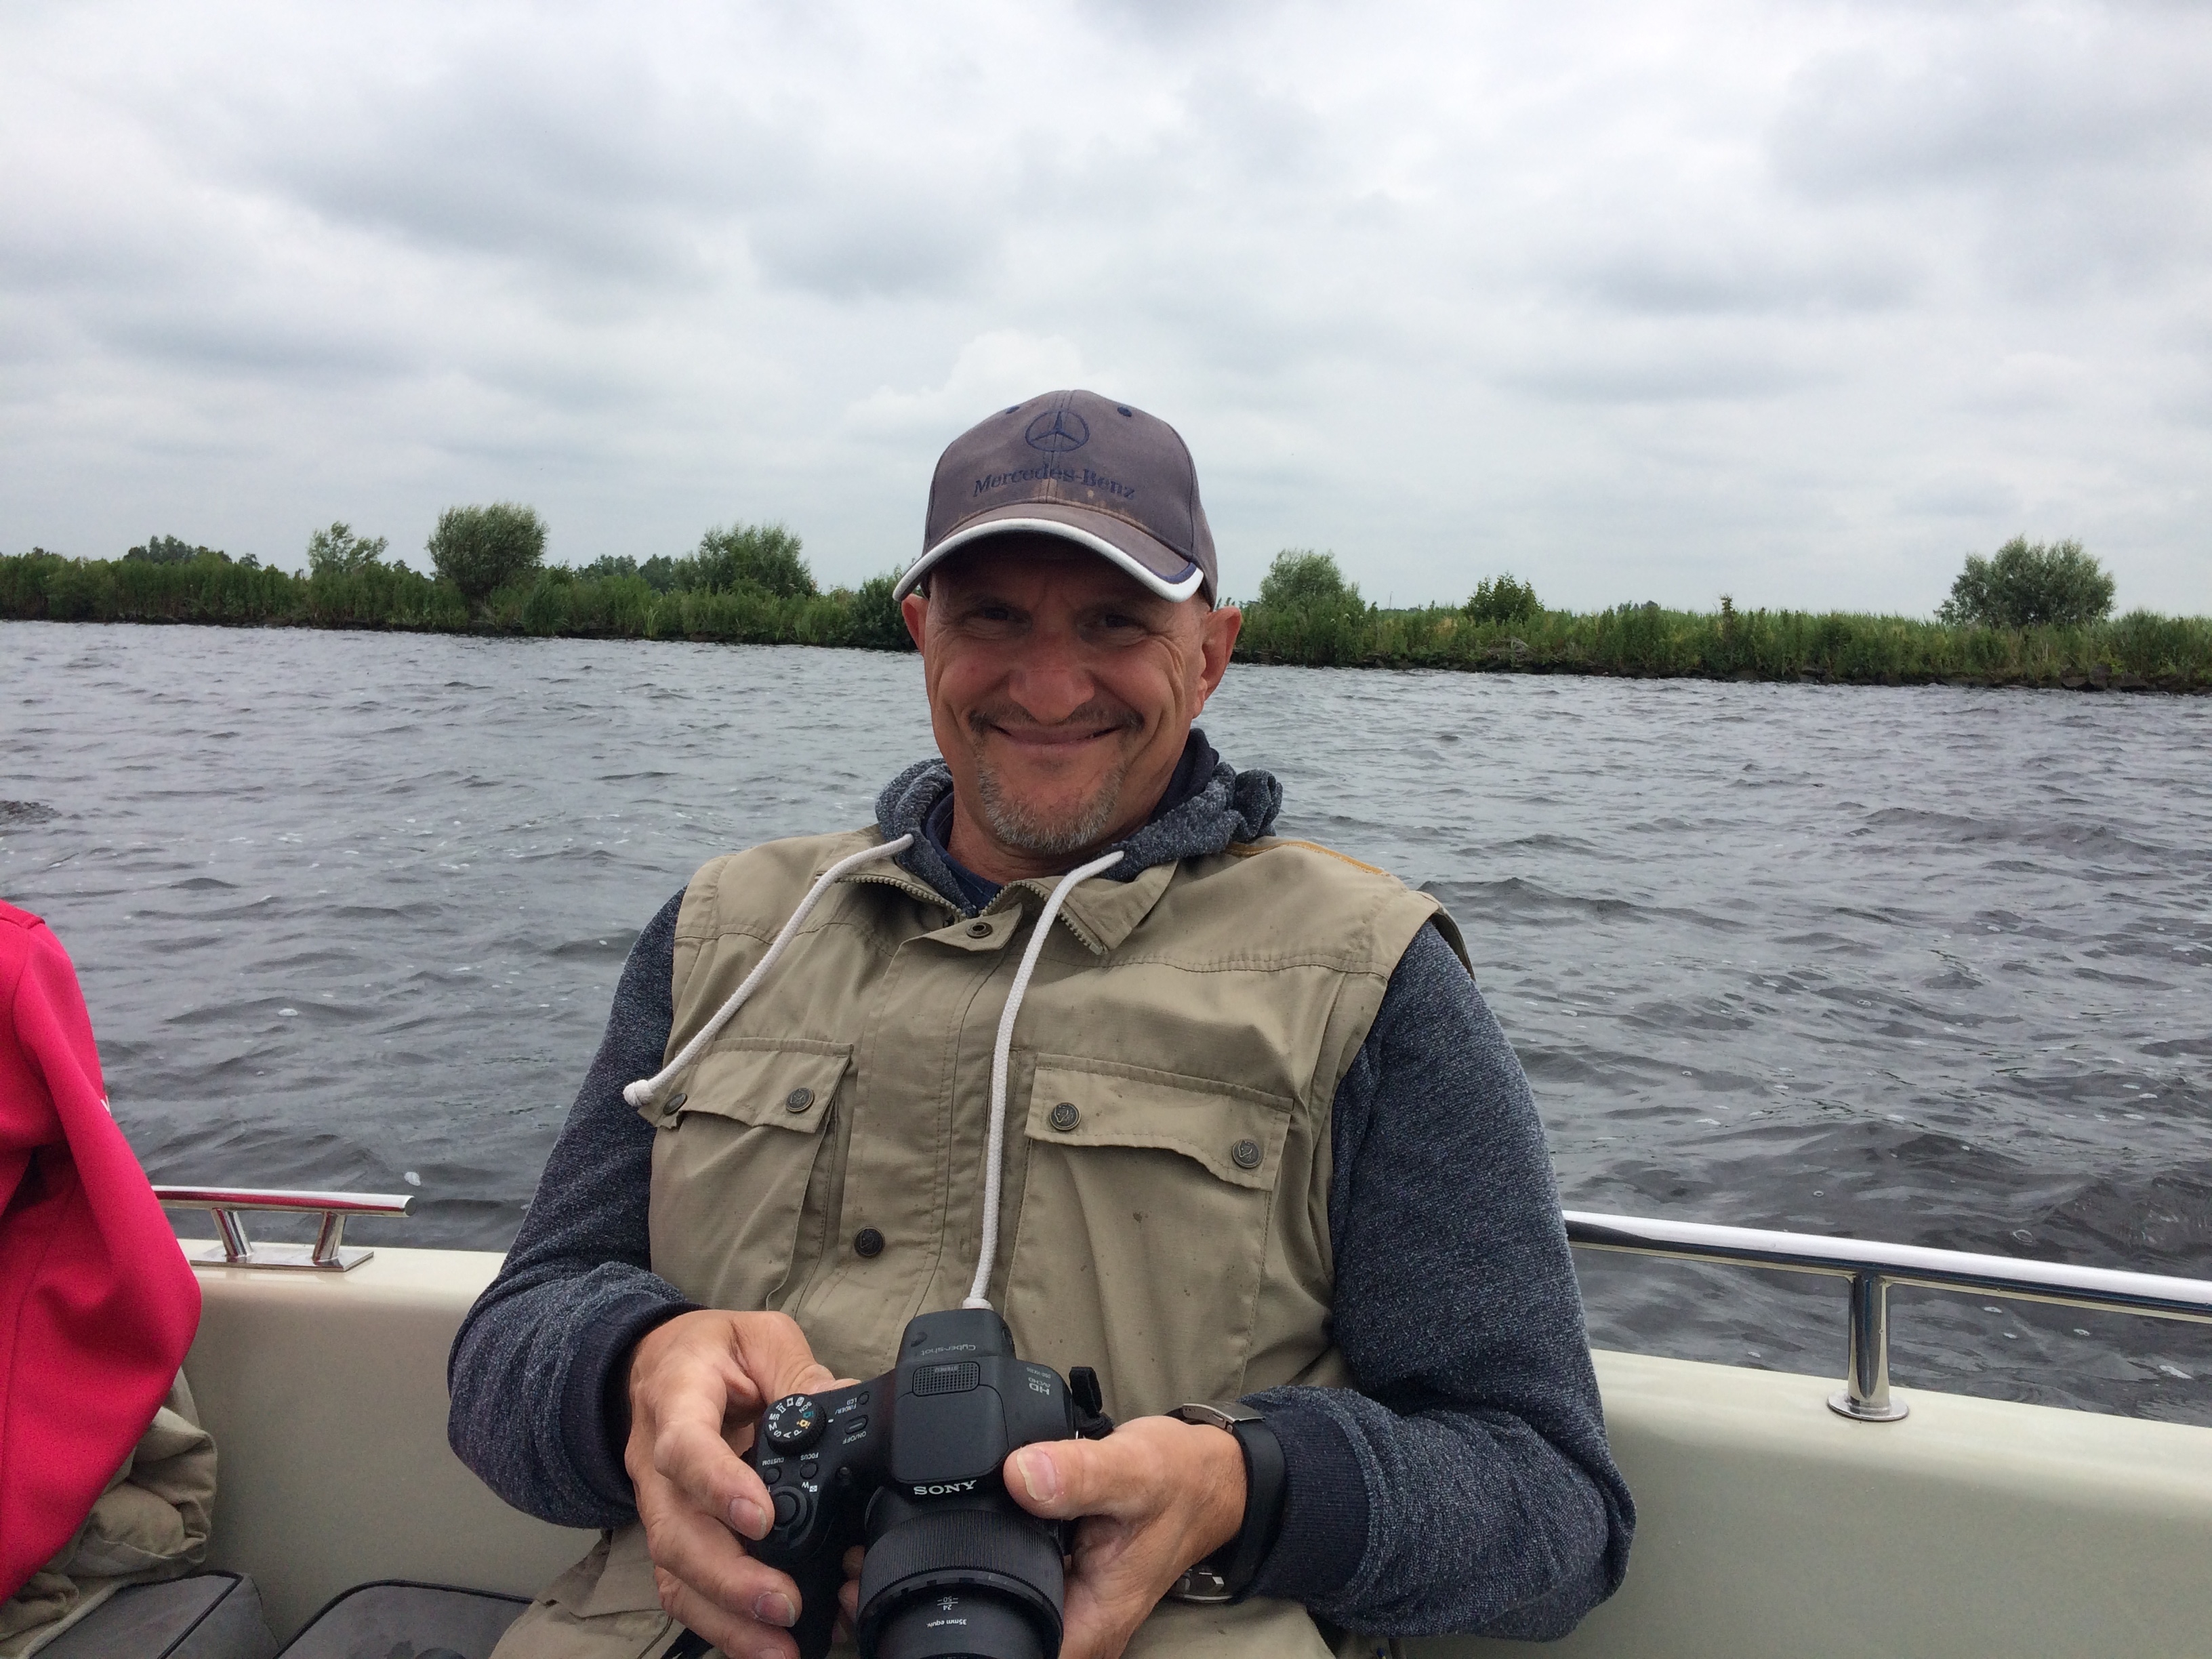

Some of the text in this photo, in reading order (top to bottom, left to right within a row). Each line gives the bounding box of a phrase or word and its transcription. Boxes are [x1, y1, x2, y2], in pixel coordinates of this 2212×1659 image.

[973, 463, 1134, 500] Mercedes-Benz
[1029, 1382, 1050, 1395] HD
[847, 1397, 857, 1406] LCD
[769, 1422, 777, 1431] M
[842, 1431, 867, 1445] ON/OFF
[762, 1457, 785, 1467] CUSTOM
[800, 1452, 819, 1461] FOCUS
[913, 1479, 977, 1495] SONY
